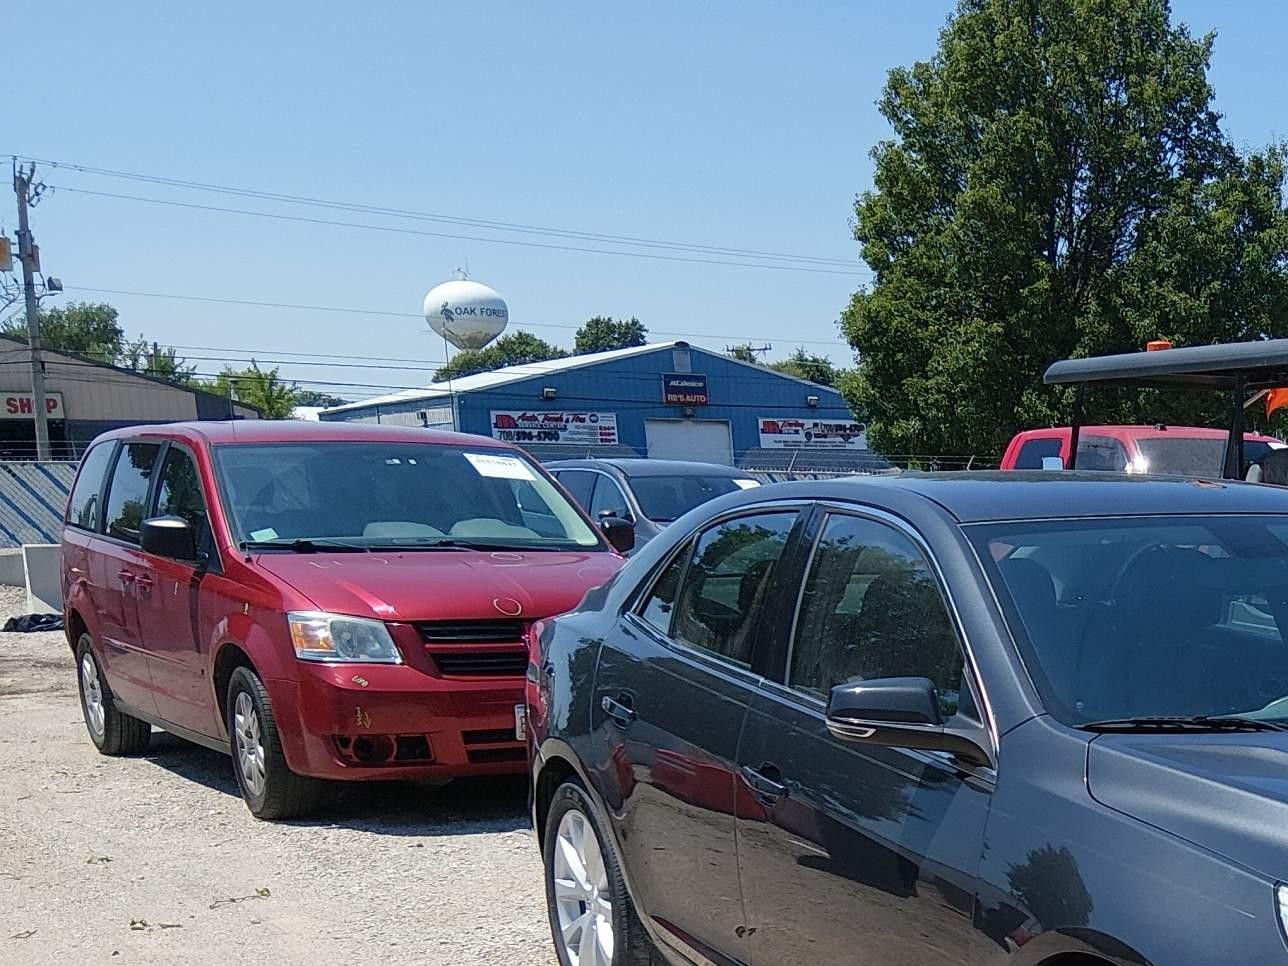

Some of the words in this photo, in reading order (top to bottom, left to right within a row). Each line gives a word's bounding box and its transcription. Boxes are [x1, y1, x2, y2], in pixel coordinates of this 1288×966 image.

[454, 306, 478, 317] OAK
[687, 394, 707, 403] AUTO
[6, 397, 58, 414] SHP
